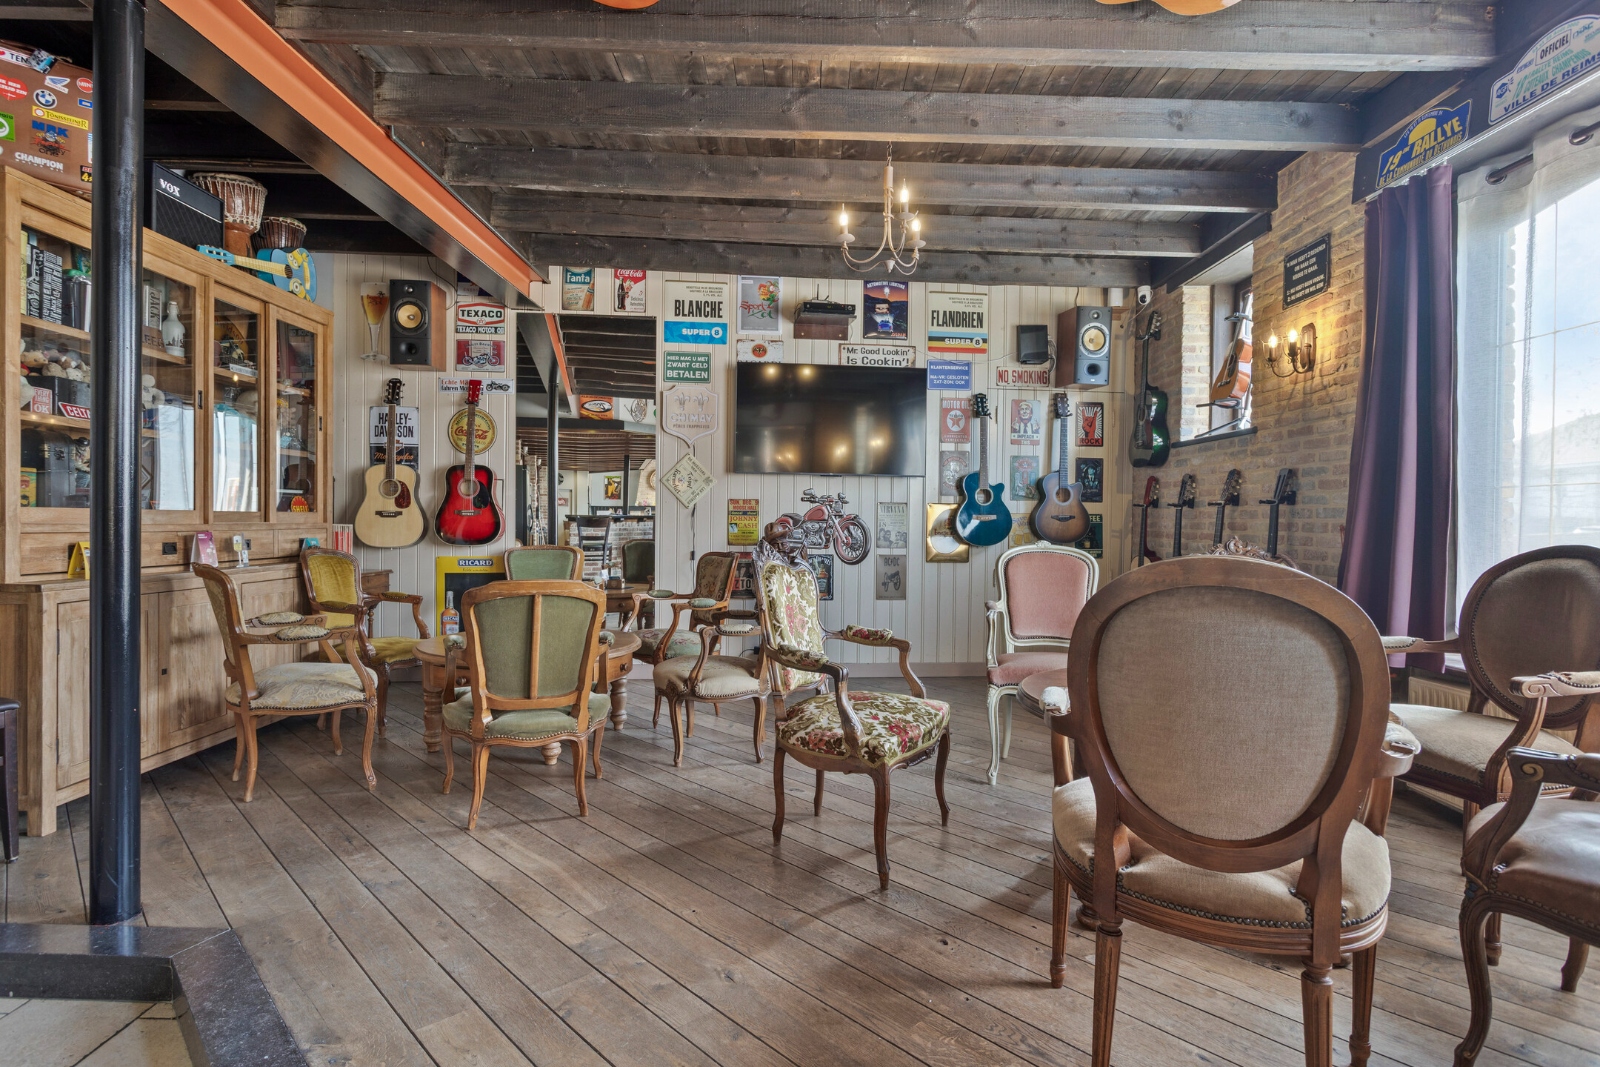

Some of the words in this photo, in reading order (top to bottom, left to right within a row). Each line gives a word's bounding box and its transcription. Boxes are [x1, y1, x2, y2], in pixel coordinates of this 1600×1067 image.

[1539, 33, 1569, 60] OFFICIEL
[1503, 89, 1537, 113] VILLE
[1541, 77, 1558, 92] DE
[1562, 52, 1600, 80] REIMS
[1411, 116, 1463, 158] RALLYE
[14, 151, 64, 170] CHAMPION
[160, 178, 180, 197] VOX
[567, 272, 591, 283] Fanta
[459, 309, 503, 319] TEXACO
[674, 299, 724, 319] BLANCHE
[931, 309, 984, 329] FLANDRIEN
[477, 326, 496, 334] MOTOR
[681, 327, 711, 336] SUPER
[944, 337, 971, 345] SUPER
[860, 347, 880, 355] Good
[882, 347, 910, 356] Lookin'
[846, 355, 858, 365] Is
[861, 356, 910, 367] Cookin'!
[666, 369, 708, 379] BETALEN
[998, 369, 1009, 383] NO
[1011, 370, 1048, 385] SMOKING
[33, 403, 50, 414] OK
[942, 400, 960, 409] MOTOR
[66, 405, 91, 419] CELT
[670, 412, 714, 423] CHIMAY
[378, 412, 412, 425] HALEY-
[374, 425, 414, 438] DAVSON
[1078, 437, 1101, 445] ROCK
[879, 505, 905, 514] NIRVANA
